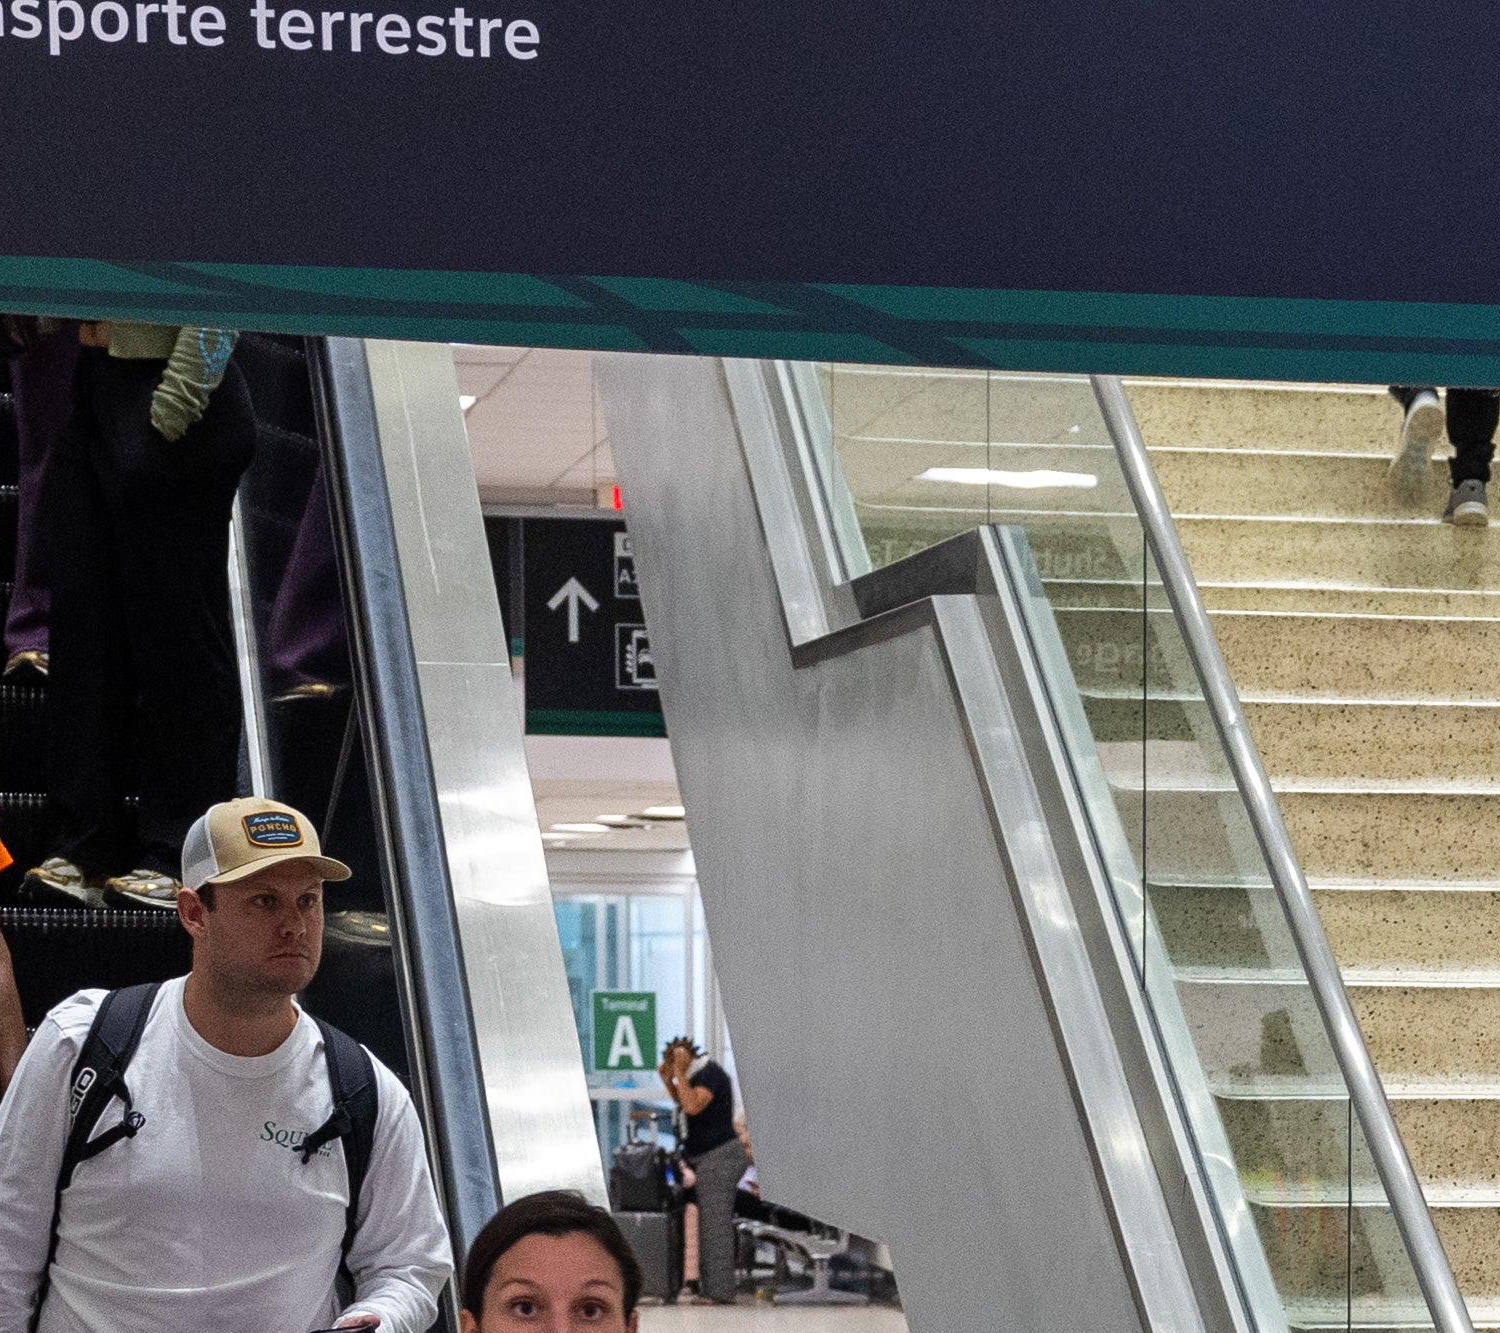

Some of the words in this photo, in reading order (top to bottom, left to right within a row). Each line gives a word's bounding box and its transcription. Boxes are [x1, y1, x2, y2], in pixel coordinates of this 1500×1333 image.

[250, 0, 540, 60] terrestre
[249, 822, 297, 833] PONCHO
[607, 1015, 645, 1067] A
